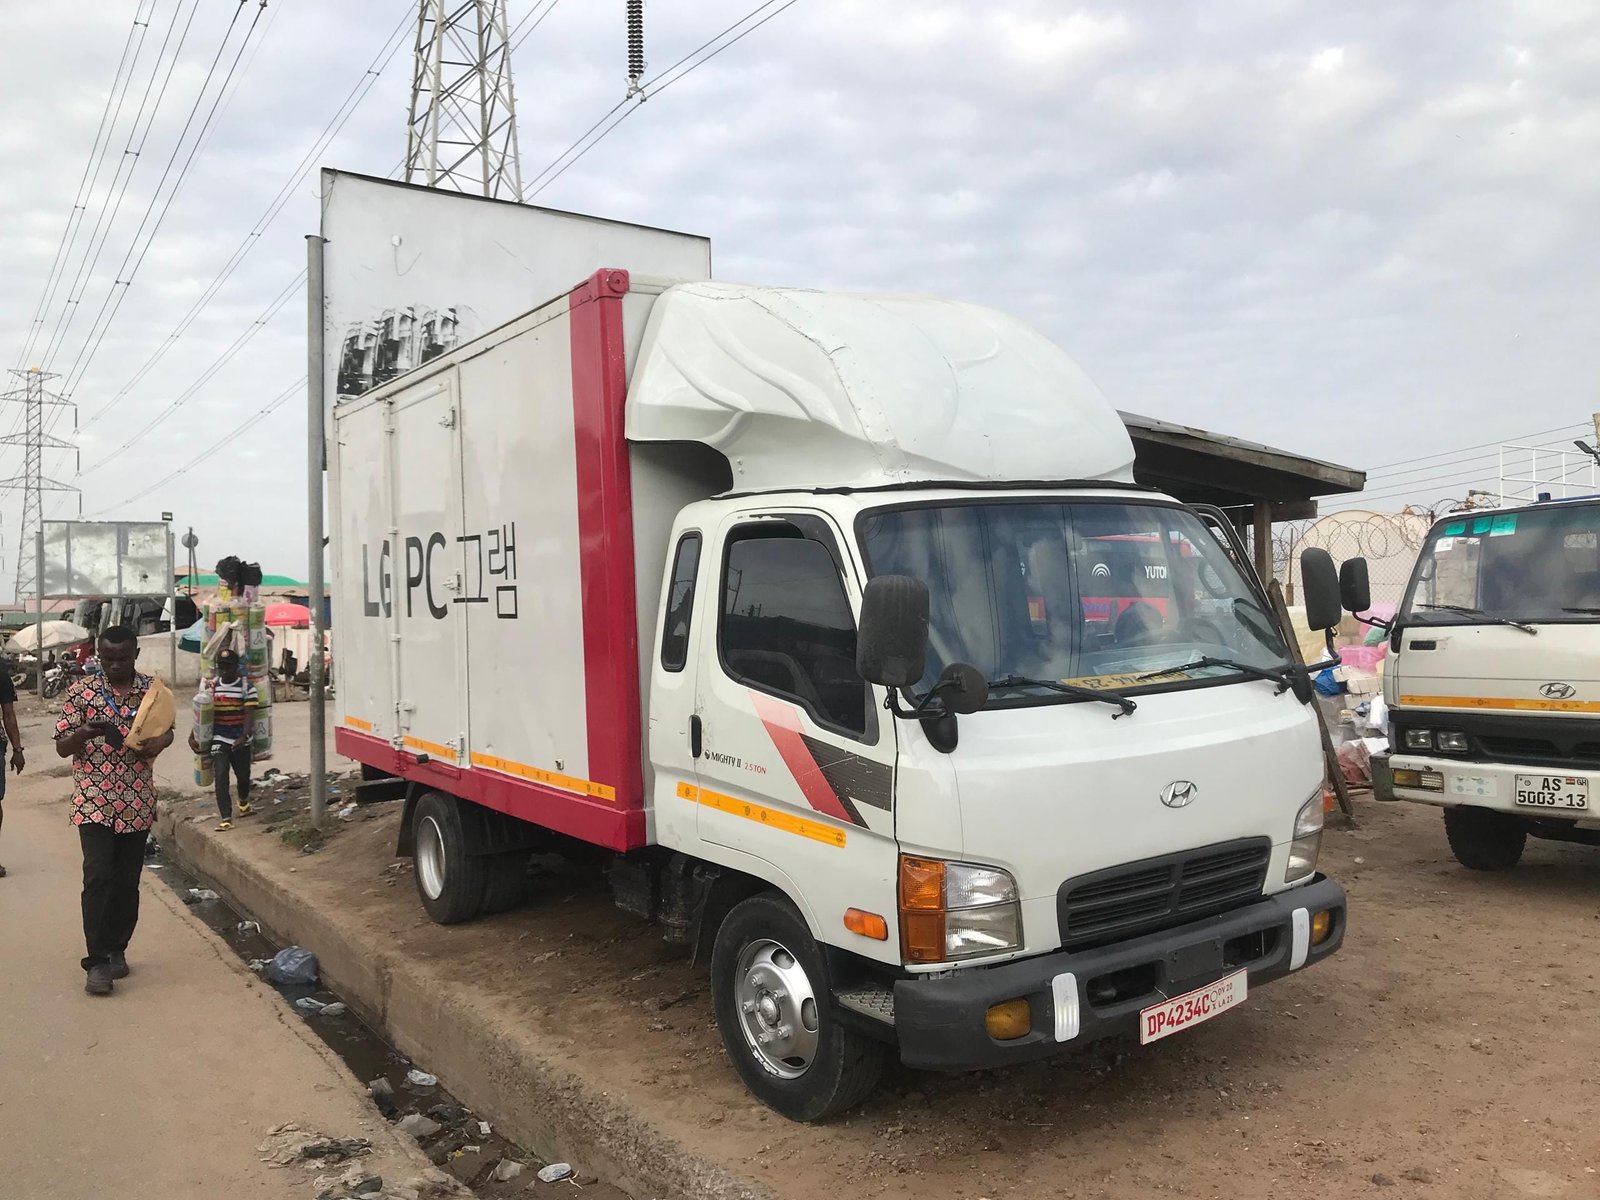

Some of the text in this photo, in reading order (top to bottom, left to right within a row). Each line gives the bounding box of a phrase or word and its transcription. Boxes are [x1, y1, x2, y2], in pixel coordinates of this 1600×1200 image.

[711, 752, 735, 767] MIGHTY
[754, 765, 766, 774] TON
[1542, 778, 1561, 791] AS
[1518, 791, 1585, 807] 5003-13
